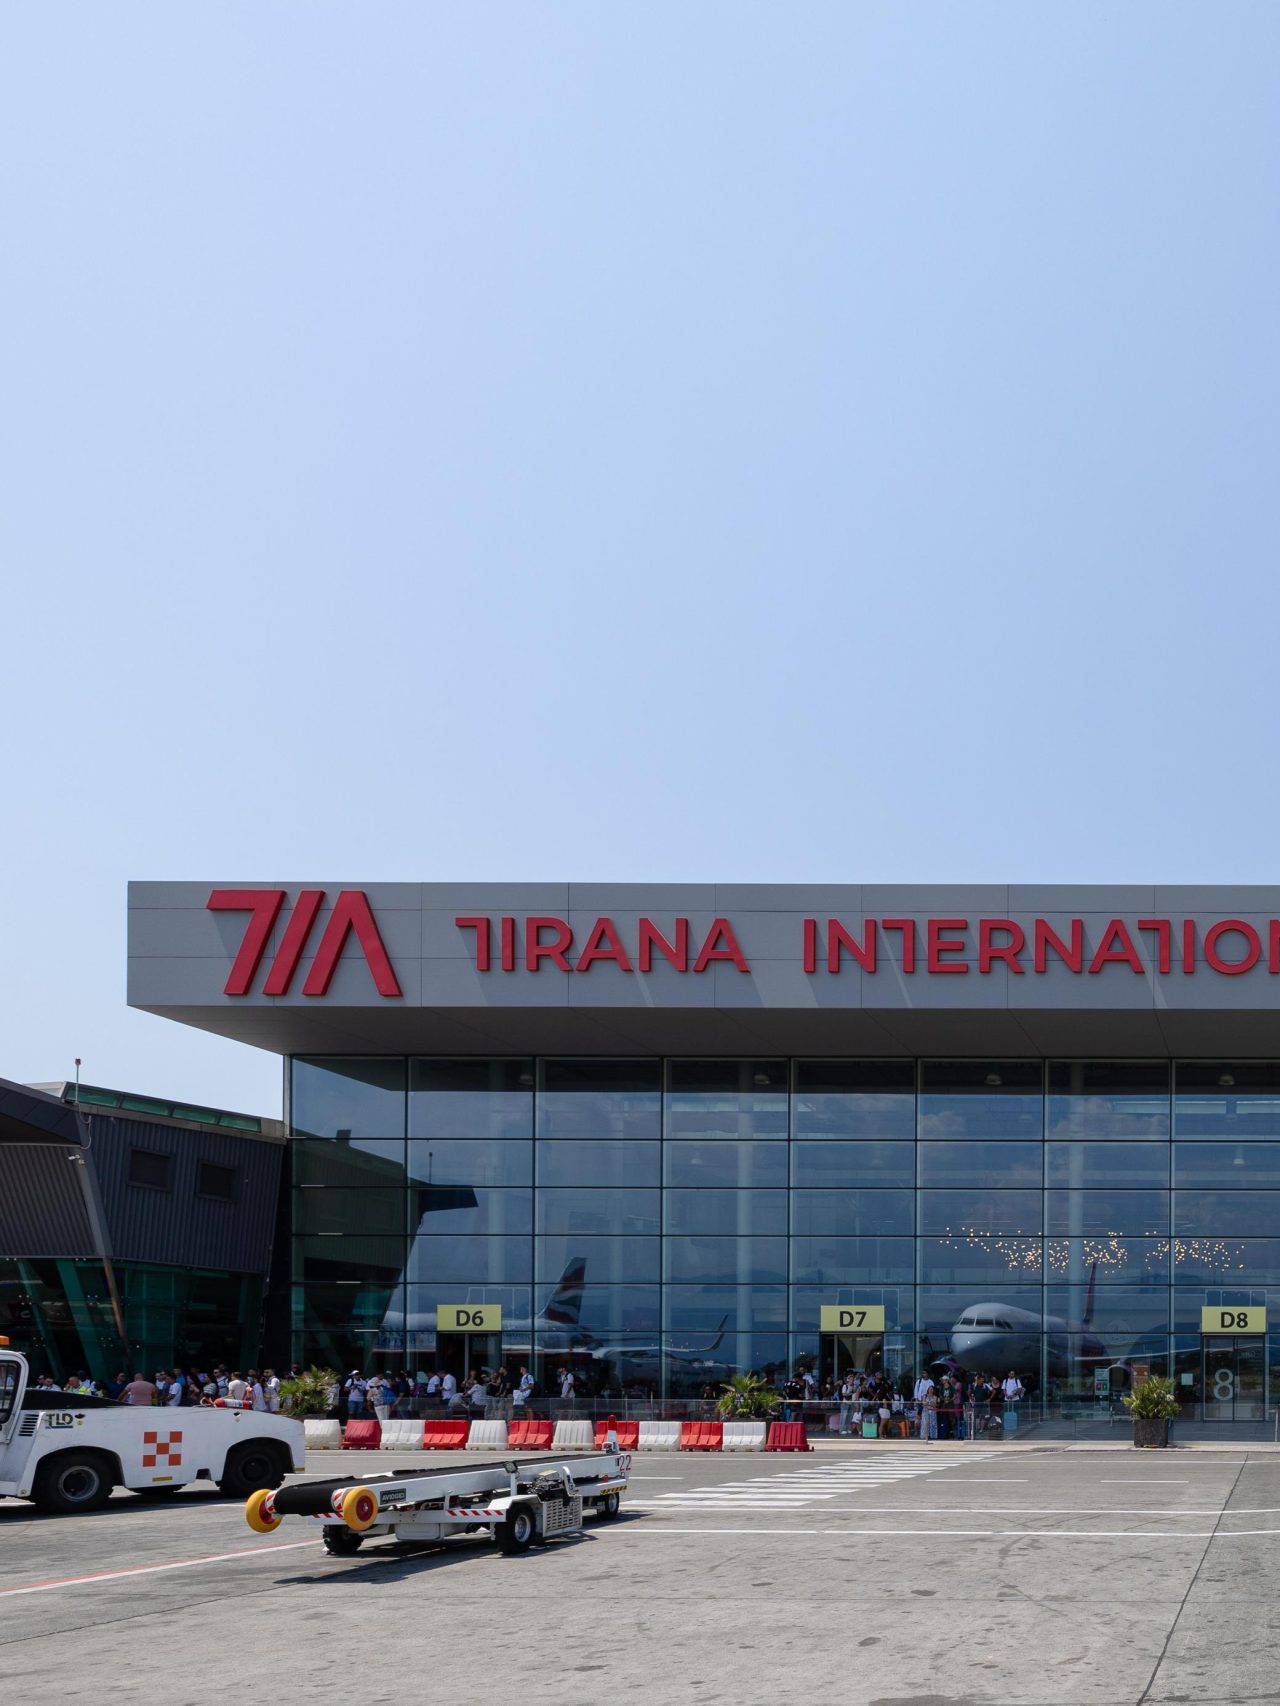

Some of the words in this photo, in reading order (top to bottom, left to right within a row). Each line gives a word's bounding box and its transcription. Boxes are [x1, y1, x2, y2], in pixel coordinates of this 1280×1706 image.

[455, 916, 750, 972] TIRANA
[455, 1309, 484, 1326] D6
[839, 1310, 867, 1327] D7
[1220, 1311, 1249, 1328] D8
[1213, 1368, 1234, 1400] 8
[46, 1413, 73, 1426] TLD
[619, 1454, 632, 1471] 22
